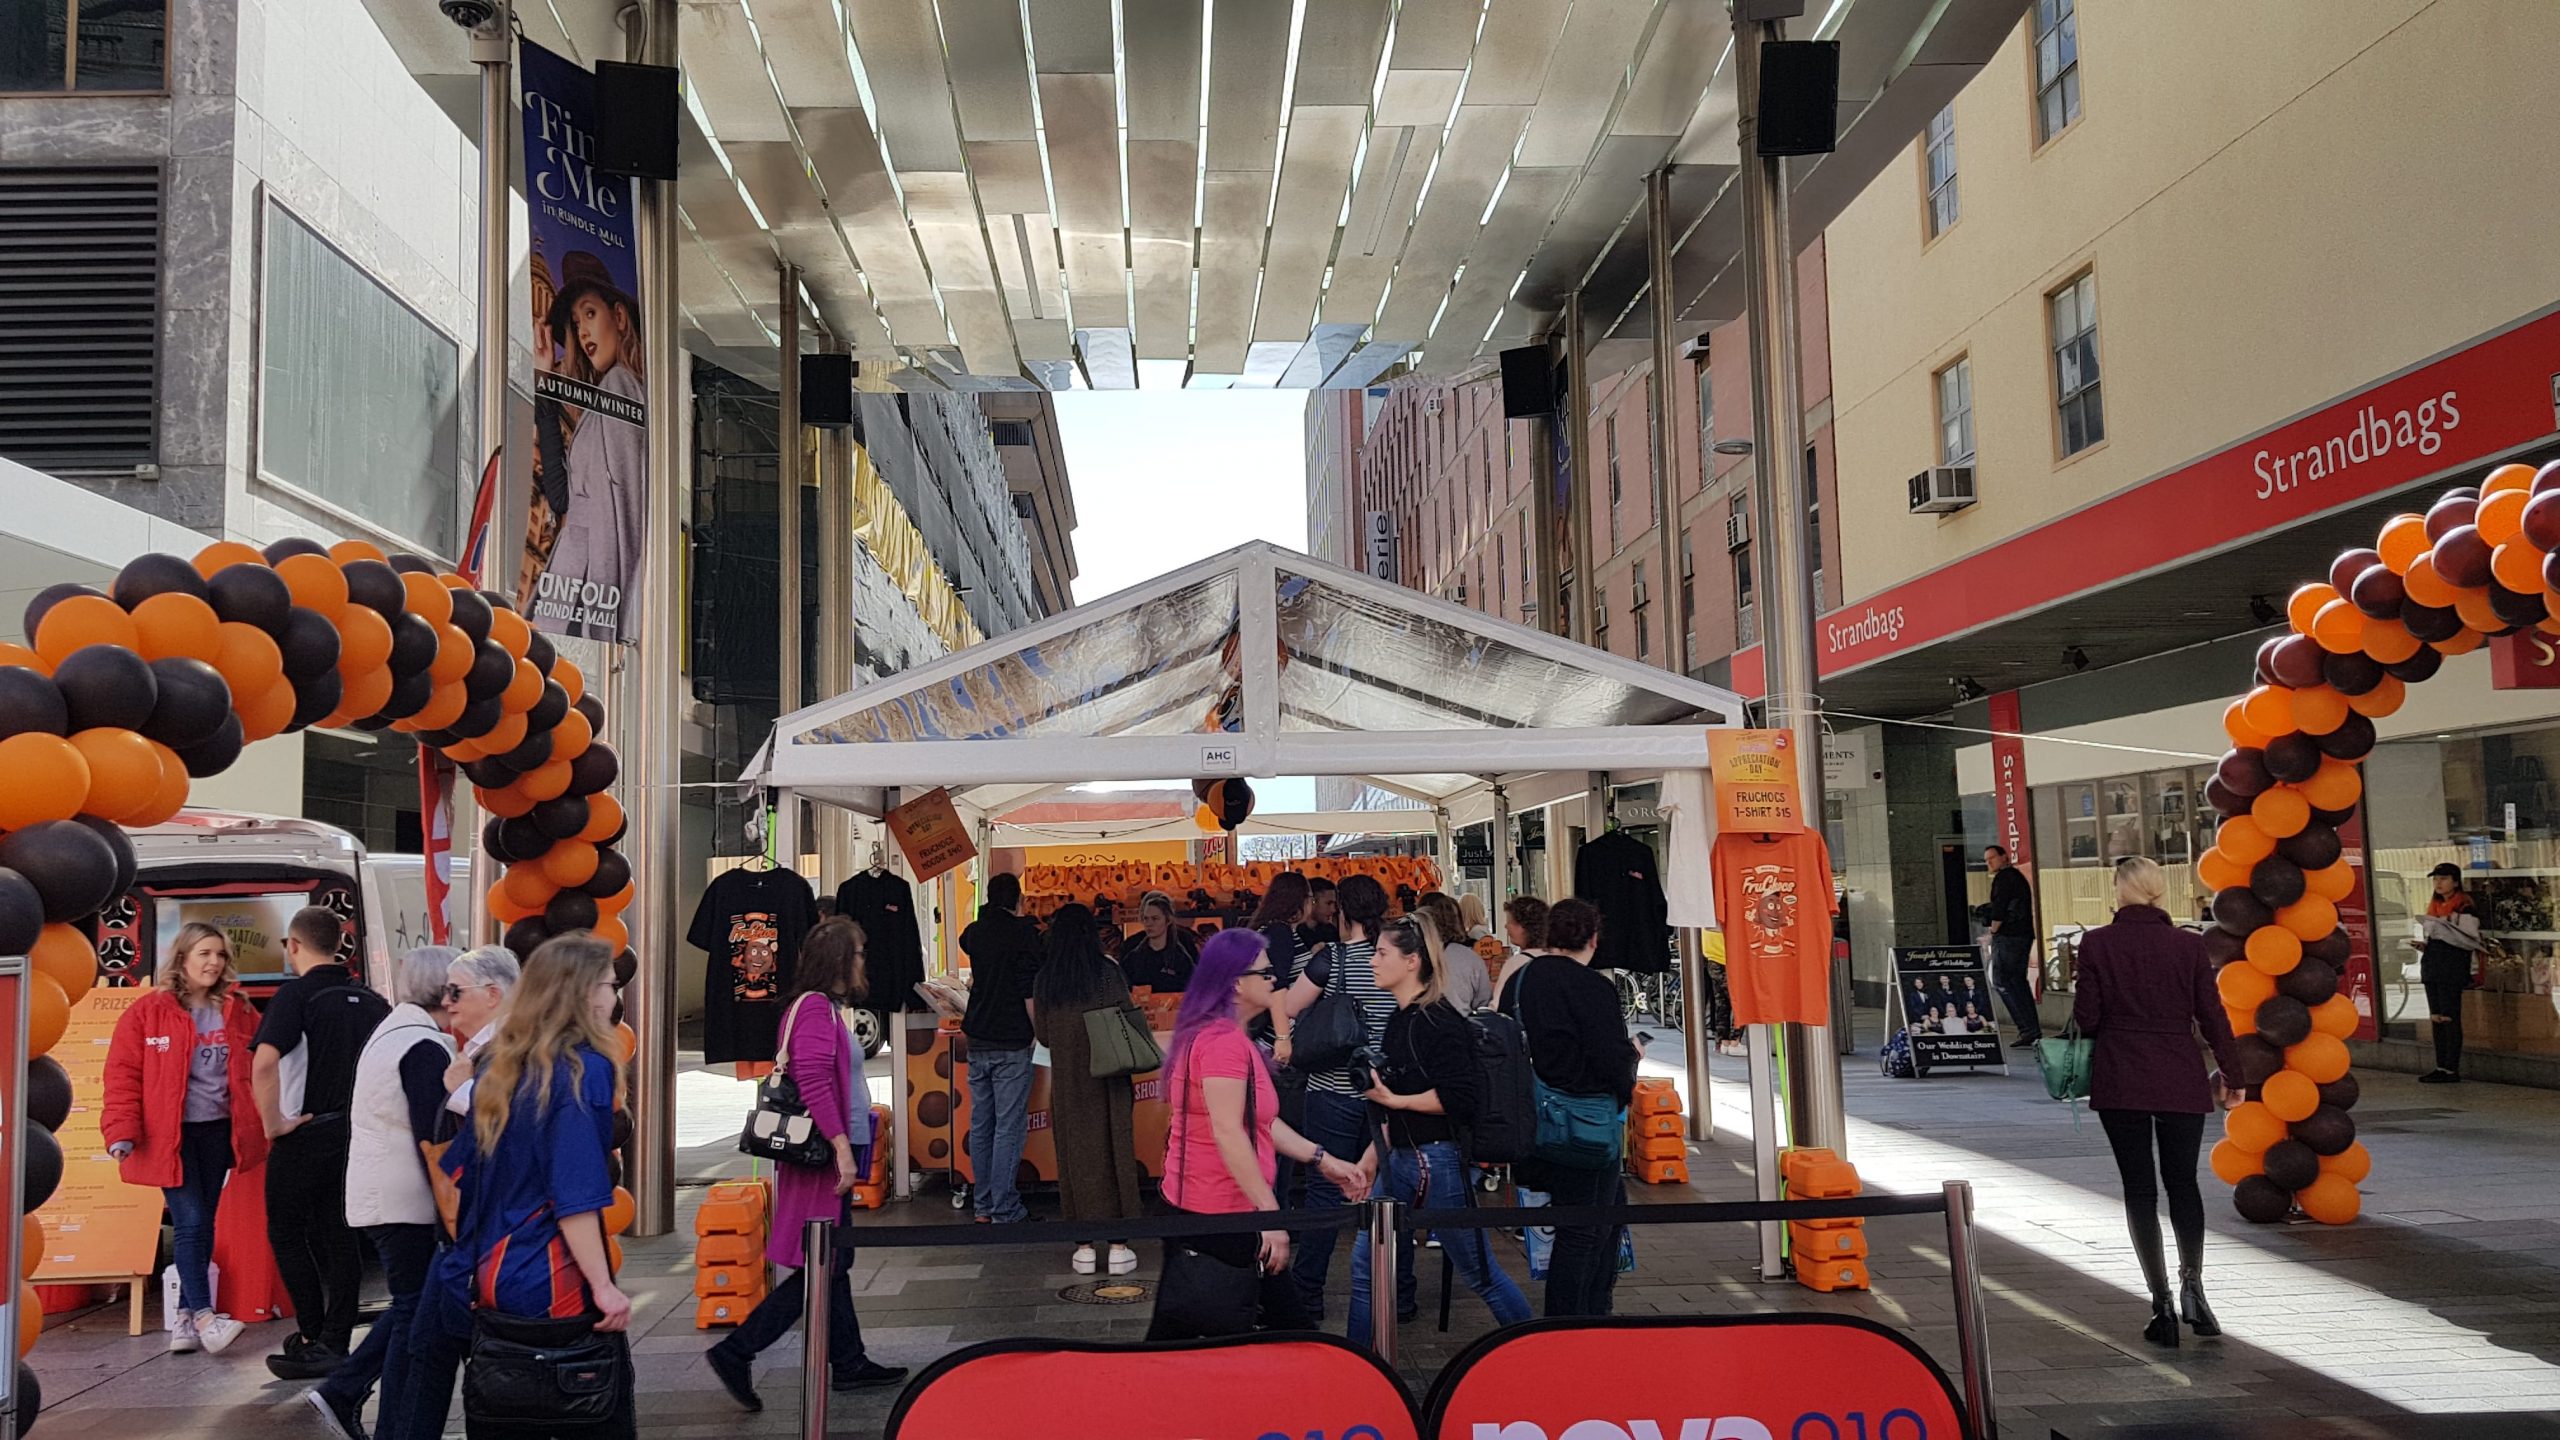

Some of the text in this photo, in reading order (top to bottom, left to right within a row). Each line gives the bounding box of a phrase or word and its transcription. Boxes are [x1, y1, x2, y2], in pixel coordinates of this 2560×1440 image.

[524, 91, 596, 166] Fin
[536, 146, 618, 218] Me
[556, 206, 597, 236] RUNDLE
[598, 227, 626, 249] MALL
[537, 376, 644, 422] AUTUMN/WINTER
[2253, 391, 2461, 500] Strandbags
[1374, 514, 1389, 580] erie
[538, 571, 621, 611] UNFOLD
[534, 599, 617, 629] RUNDLE MALL
[1828, 606, 1905, 654] Strandbags
[1206, 750, 1231, 761] AHC
[1729, 753, 1782, 769] APPRECIATION
[1749, 763, 1763, 774] DAY
[1733, 806, 1792, 818] T-SHIRT $15
[1736, 791, 1786, 803] FRUCHOCS
[201, 1045, 230, 1065] 919
[1917, 1040, 1996, 1051] Our Wedding Store
[1942, 1052, 1986, 1060] Downstairs
